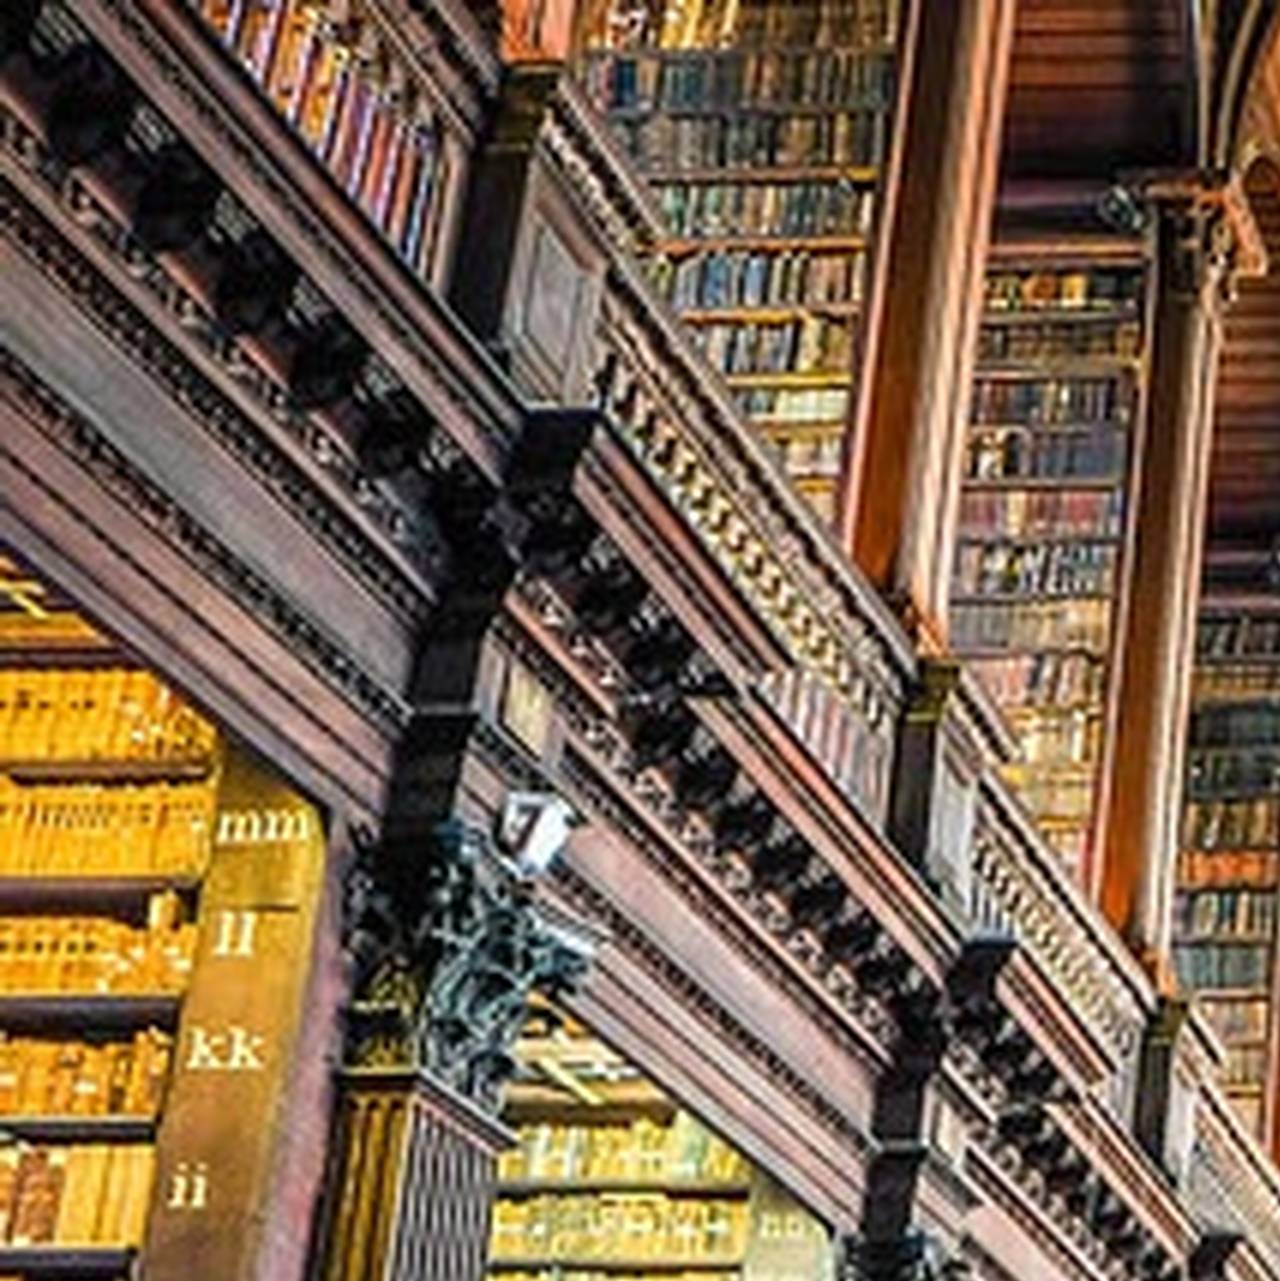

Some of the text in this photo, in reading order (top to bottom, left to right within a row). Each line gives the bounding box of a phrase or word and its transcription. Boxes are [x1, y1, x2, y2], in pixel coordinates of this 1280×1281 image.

[216, 807, 310, 846] mm
[186, 1027, 264, 1070] kk
[168, 1163, 207, 1208] ii
